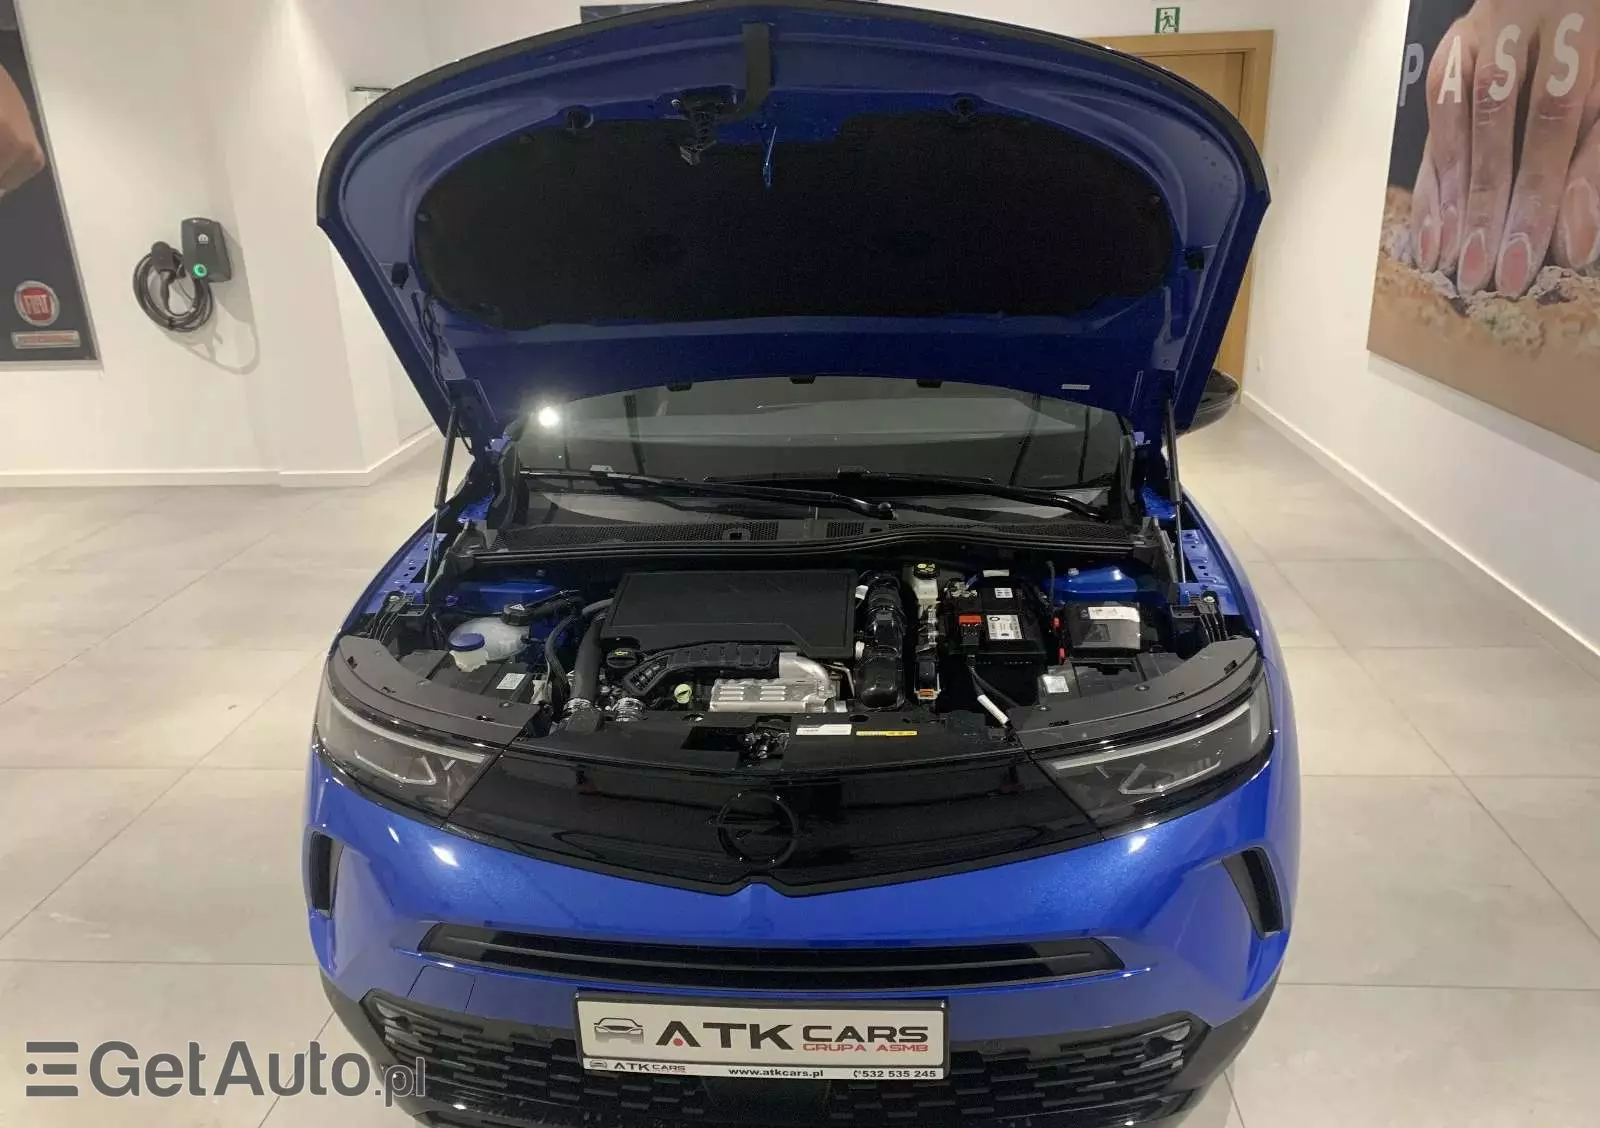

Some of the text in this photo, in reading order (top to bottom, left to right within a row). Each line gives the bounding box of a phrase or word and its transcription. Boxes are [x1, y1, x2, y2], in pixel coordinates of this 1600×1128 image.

[656, 1020, 929, 1050] ATK CARS
[803, 1043, 929, 1052] GRUPA ASMB
[614, 1062, 650, 1071] ATK
[728, 1067, 824, 1078] www.atkcars.pl
[864, 1070, 937, 1078] 532 535 245
